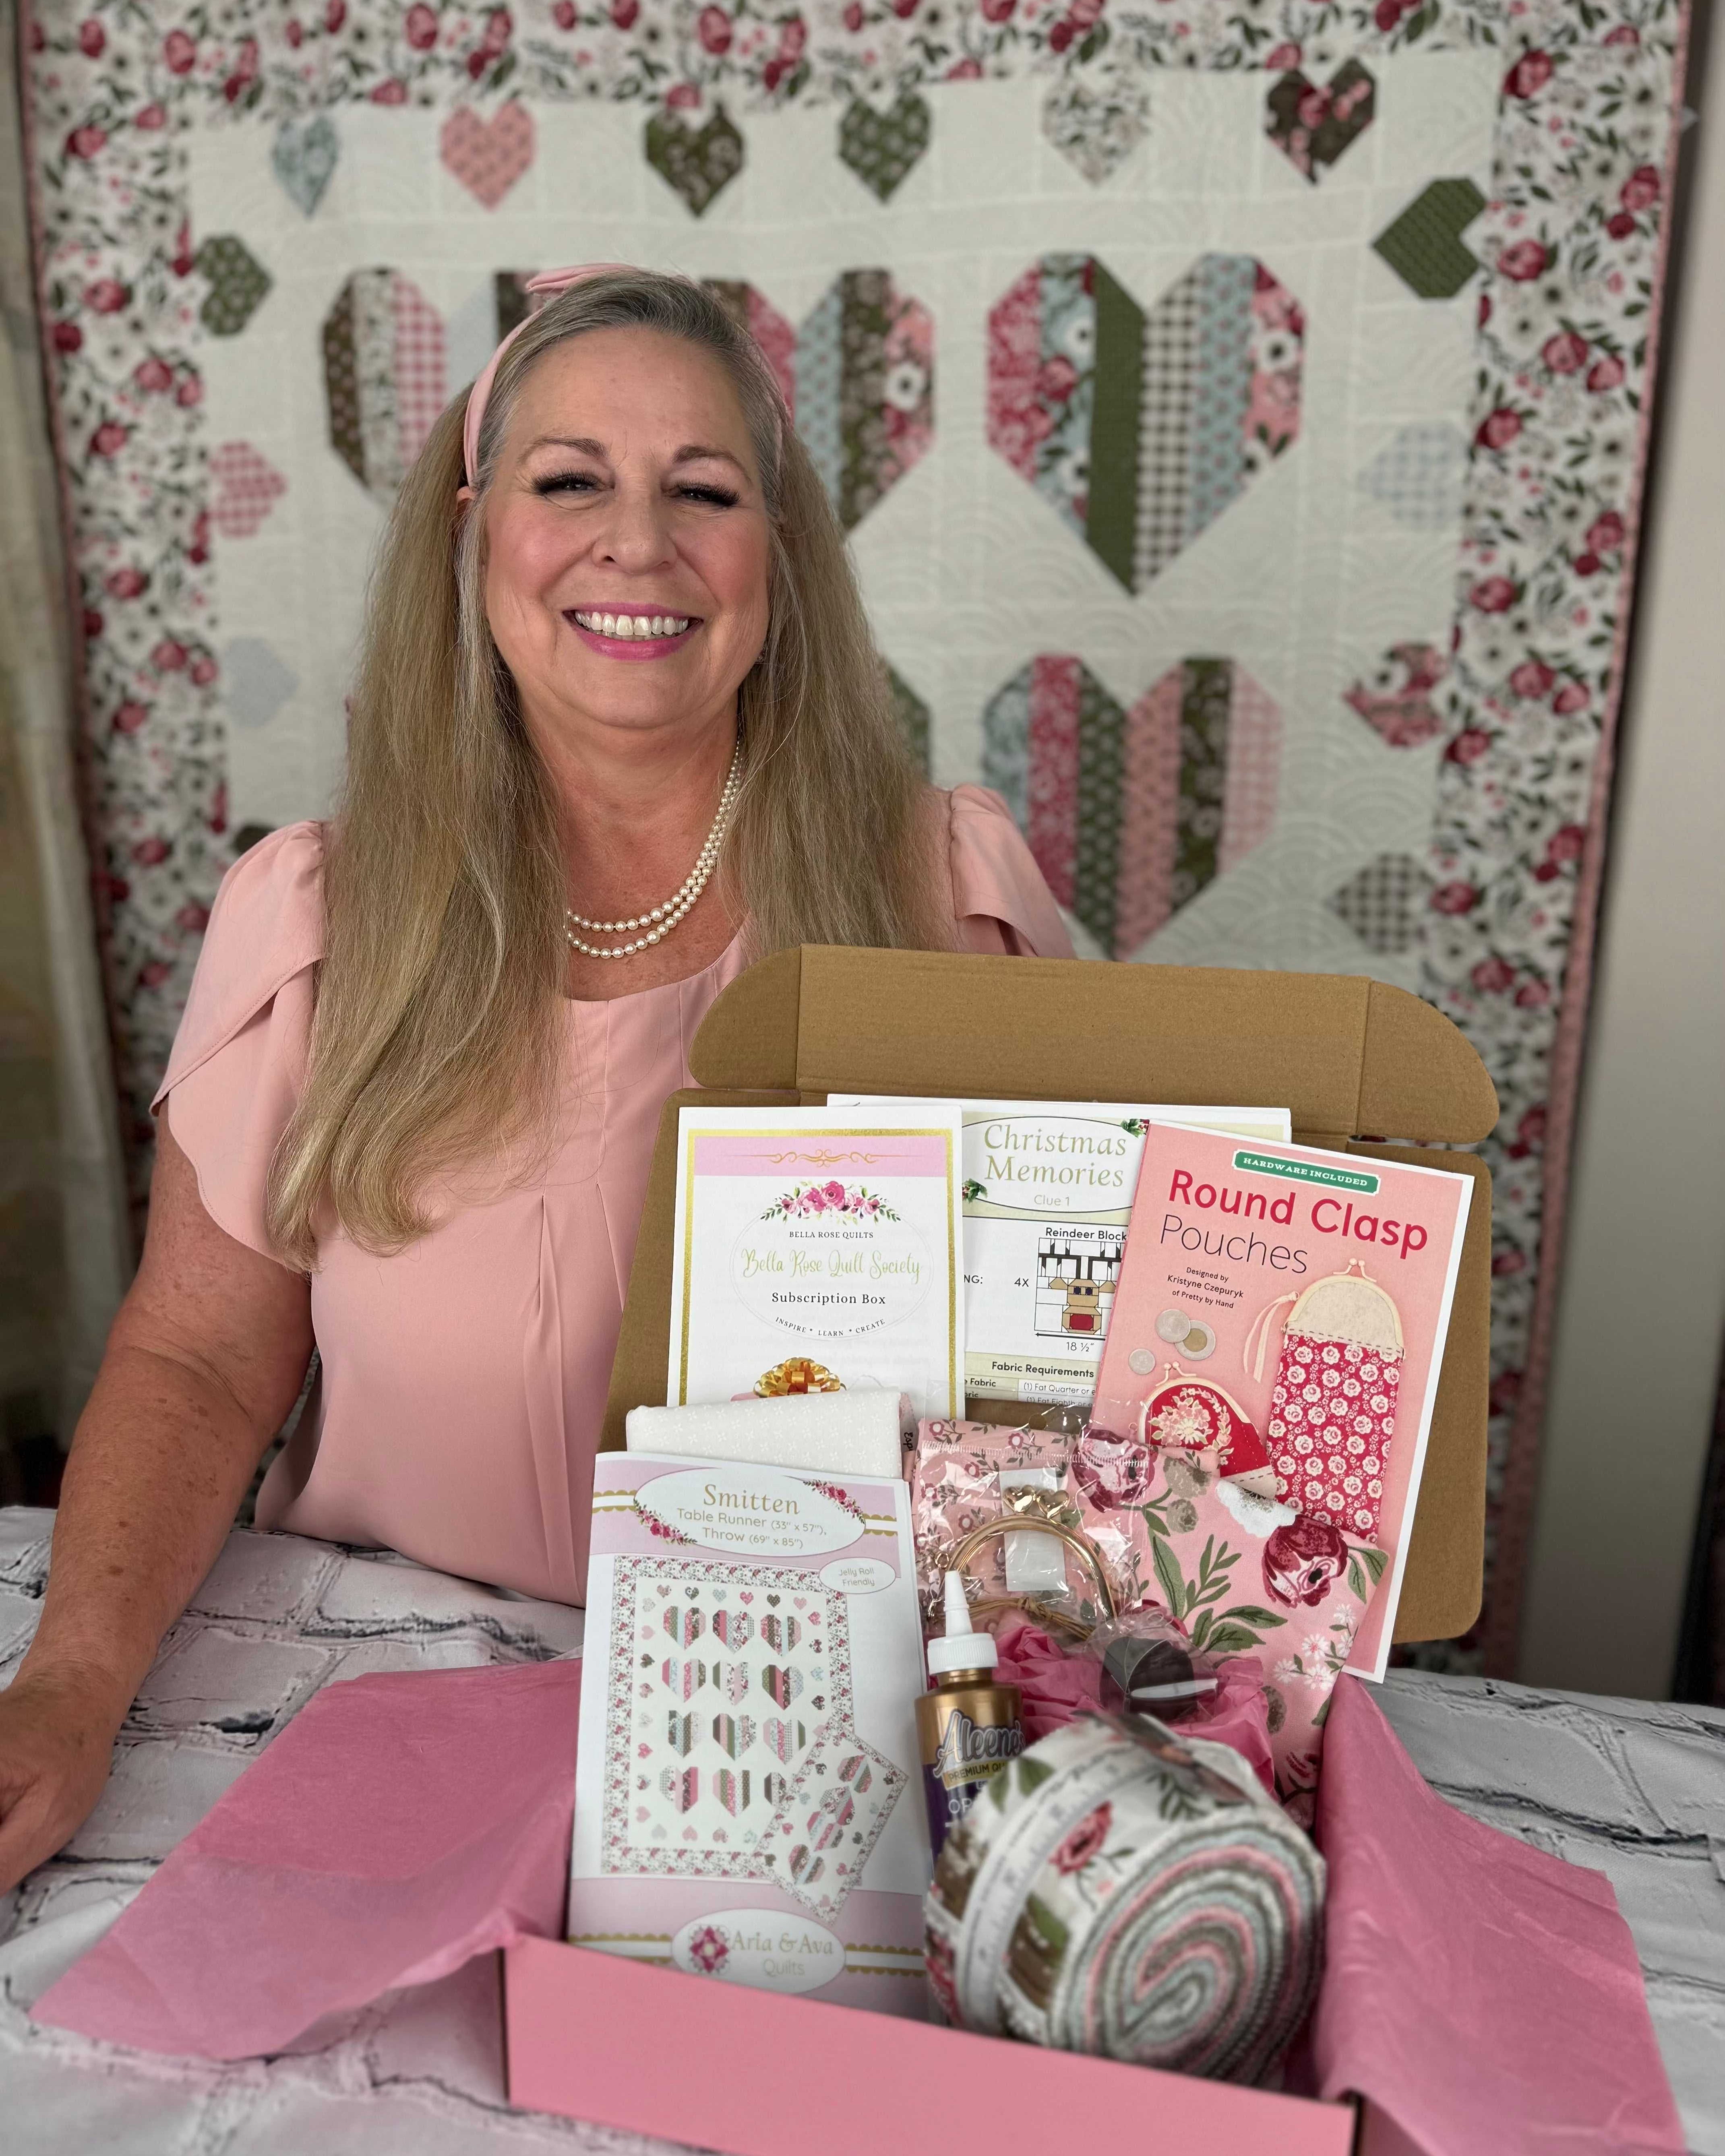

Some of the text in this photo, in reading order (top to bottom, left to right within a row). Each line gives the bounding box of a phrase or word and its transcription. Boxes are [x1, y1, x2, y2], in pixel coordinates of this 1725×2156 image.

[983, 1123, 1126, 1156] Christmas
[984, 1155, 1124, 1187] Memories
[1243, 1158, 1368, 1186] HARDWARE INCLUDED
[1034, 1194, 1070, 1207] Clue 1
[1168, 1168, 1428, 1260] Round Clasp
[818, 1231, 840, 1239] ROSE
[842, 1231, 874, 1240] QUILTS
[1045, 1227, 1094, 1240] Reindeer
[1160, 1213, 1308, 1274] Pouches
[741, 1249, 784, 1278] Bella
[789, 1249, 822, 1278] Rose
[869, 1250, 921, 1285] Society
[1186, 1267, 1229, 1283] Designed by
[1014, 1277, 1029, 1287] 4X
[1167, 1274, 1244, 1298] Kristyne Czepuryk
[771, 1292, 886, 1306] Subscription Box
[1181, 1291, 1203, 1303] Pretty
[1205, 1296, 1214, 1305] by
[1215, 1299, 1234, 1309] Hand
[775, 1317, 807, 1333] INSPIRE
[855, 1318, 885, 1333] CREATE
[1066, 1342, 1077, 1352] 18
[992, 1361, 1094, 1378] Fabric Requirements
[970, 1378, 996, 1387] Fabric
[1024, 1382, 1032, 1391] (1)
[1049, 1384, 1079, 1394] Quarter
[703, 1484, 800, 1515] Smitten
[676, 1508, 714, 1522] Table
[718, 1512, 767, 1528] Runner
[702, 1527, 745, 1542] Throw
[839, 1567, 874, 1577] Jelly Roll
[842, 1578, 875, 1586] Friendly
[949, 1764, 989, 1783] PREMIUM
[730, 1930, 834, 1955] Aria & Ava
[763, 1958, 805, 1978] Quilts
